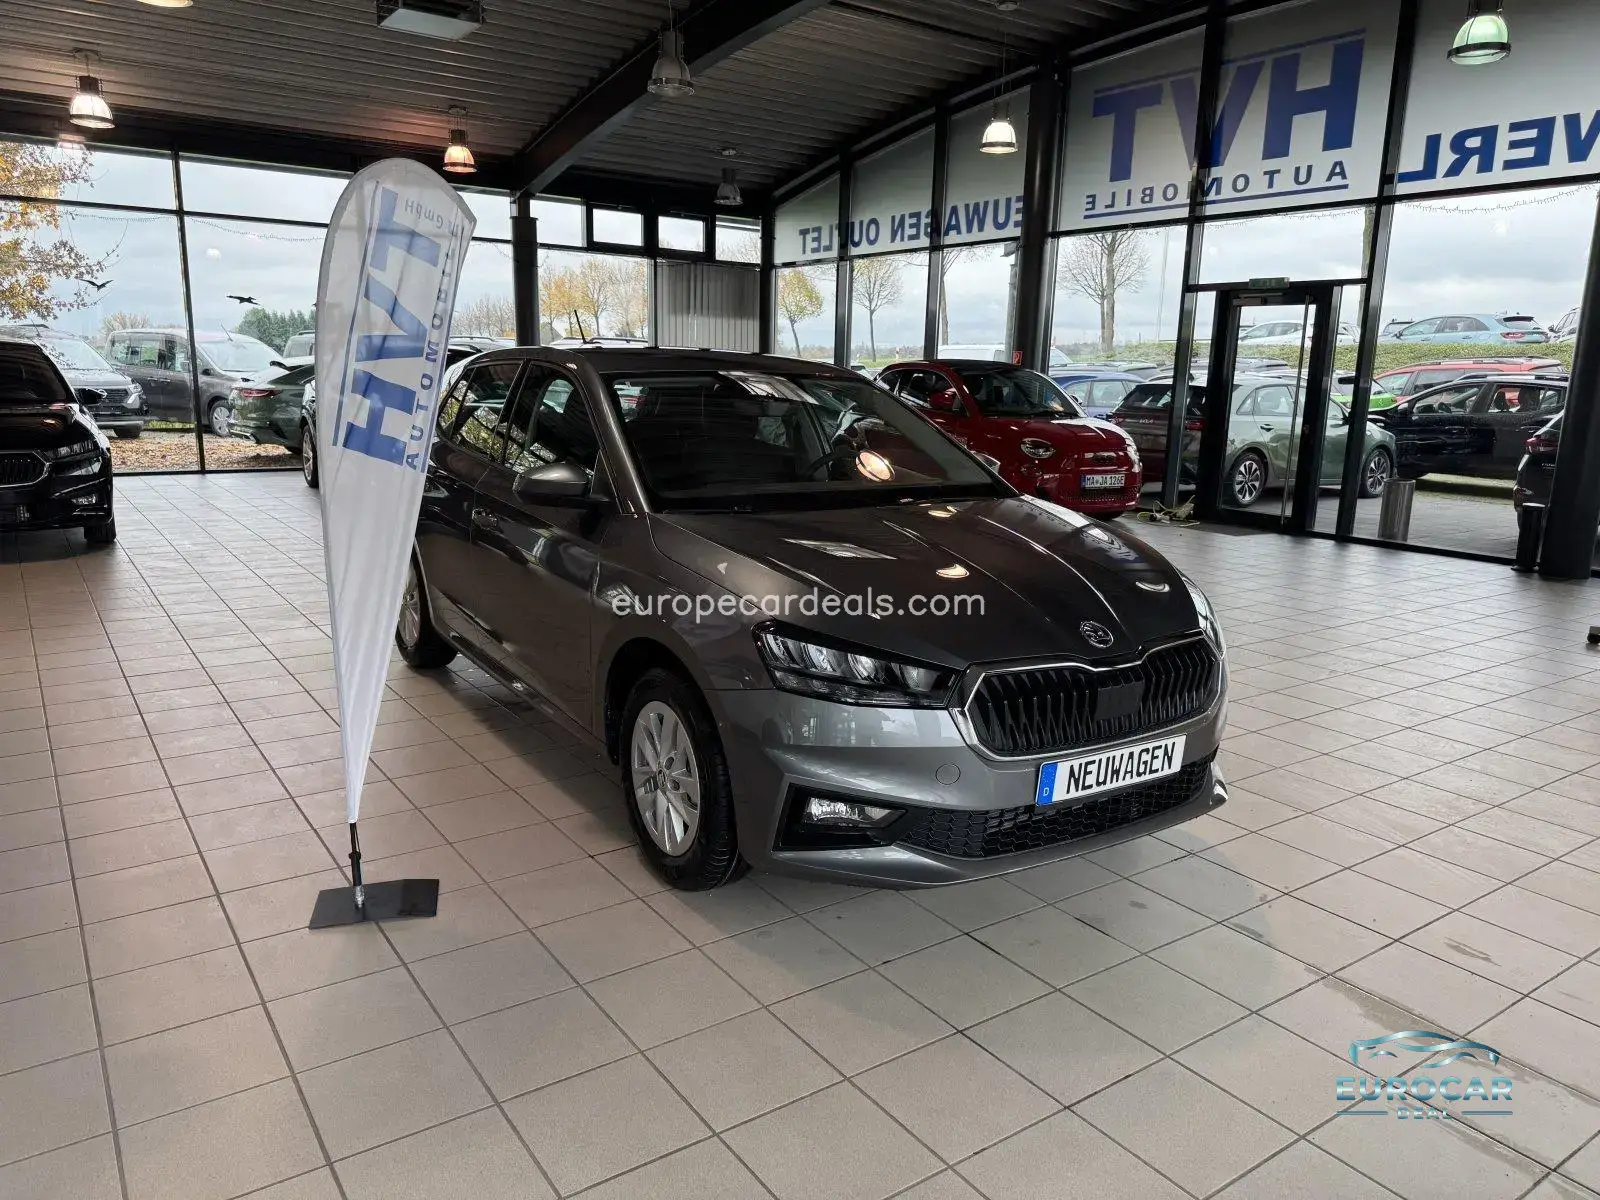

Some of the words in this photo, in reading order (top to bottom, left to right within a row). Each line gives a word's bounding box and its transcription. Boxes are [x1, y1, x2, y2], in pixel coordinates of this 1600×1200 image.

[404, 197, 444, 230] GmbH
[342, 186, 442, 467] HVT
[1086, 475, 1095, 486] MA
[1100, 475, 1108, 486] JA
[1042, 787, 1050, 797] D
[1066, 741, 1176, 795] NEUWAGEN
